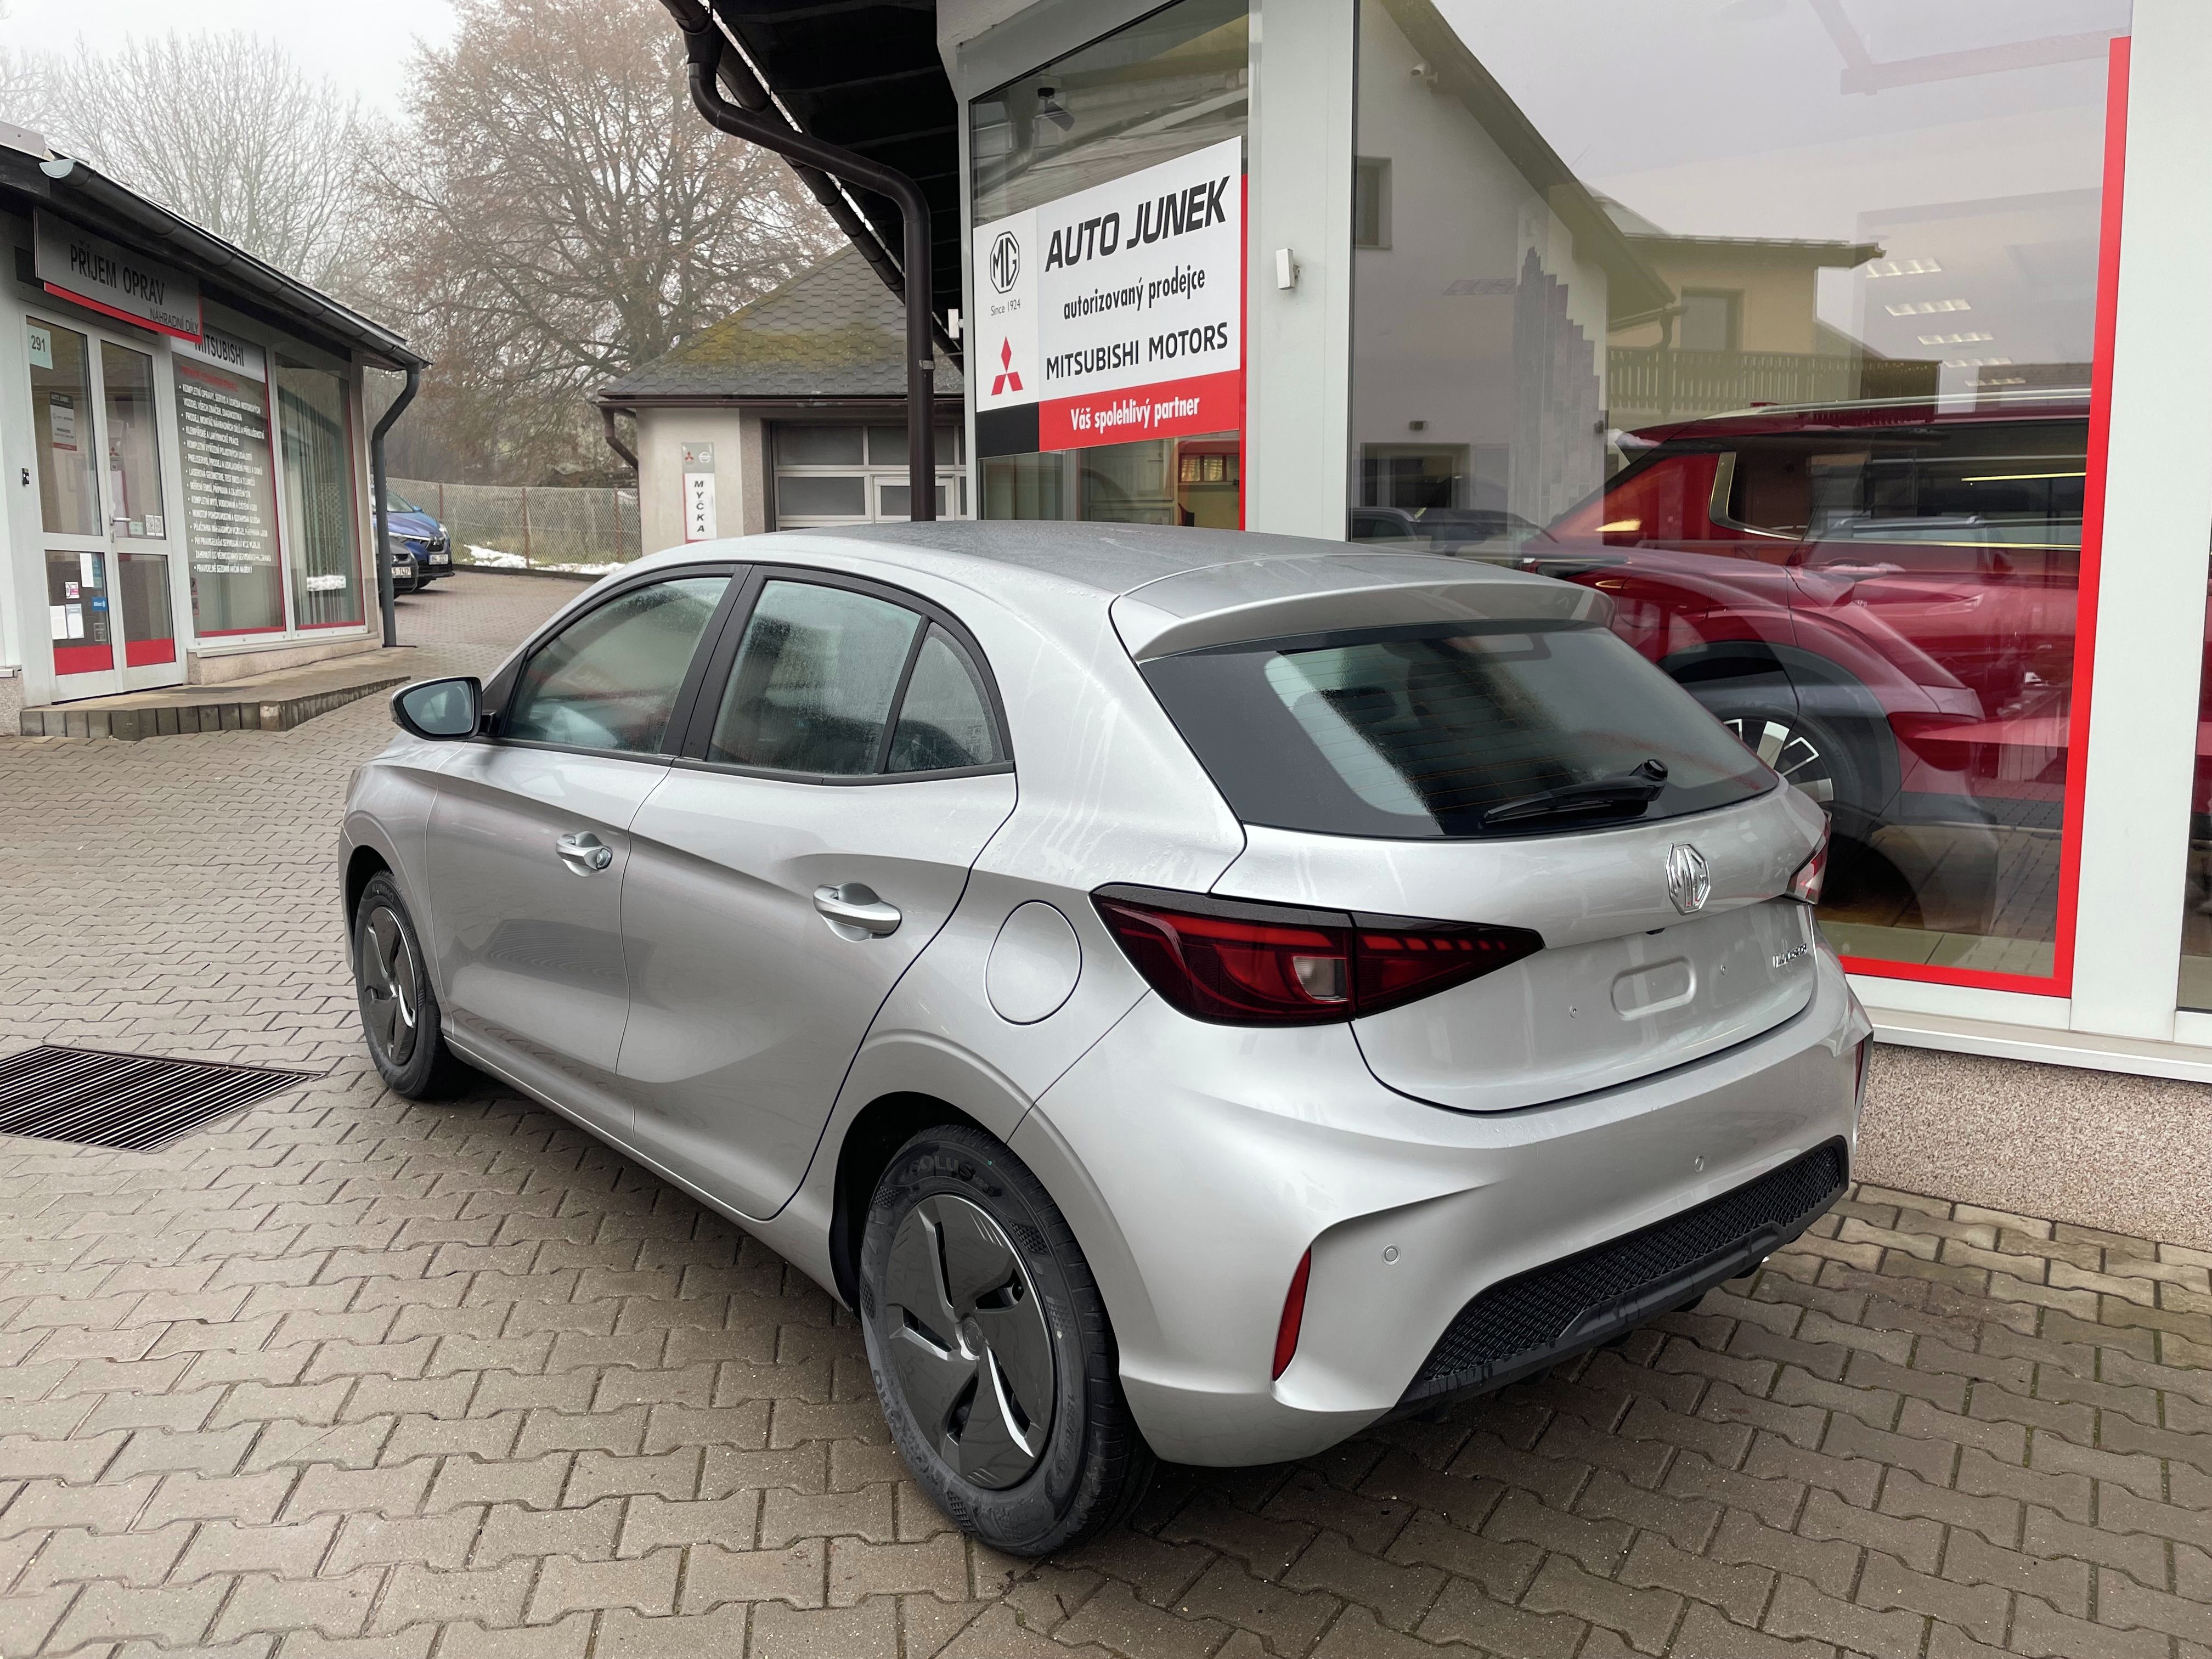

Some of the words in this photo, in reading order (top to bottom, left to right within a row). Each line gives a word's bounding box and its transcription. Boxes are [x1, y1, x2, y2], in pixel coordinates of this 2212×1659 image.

[1045, 212, 1120, 273] AUTO
[1126, 176, 1231, 250] JUNEK
[70, 241, 117, 289] PŘÍJEM
[123, 267, 165, 306] OPRAV
[992, 236, 1018, 289] MG
[991, 305, 1005, 317] Since
[1007, 298, 1021, 312] 1924
[1063, 277, 1144, 320] autorizovaný
[1148, 265, 1205, 309] prodejce
[31, 335, 46, 352] 291
[150, 308, 184, 330] NÁHRADNÍ
[186, 318, 199, 334] DÍLY
[1046, 339, 1139, 380] MITSUBISHI
[1149, 321, 1228, 362] MOTORS
[1070, 407, 1091, 431] Váš
[1094, 398, 1151, 435] spolehlivý
[1154, 396, 1200, 427] partner
[694, 480, 705, 532] MYČKA
